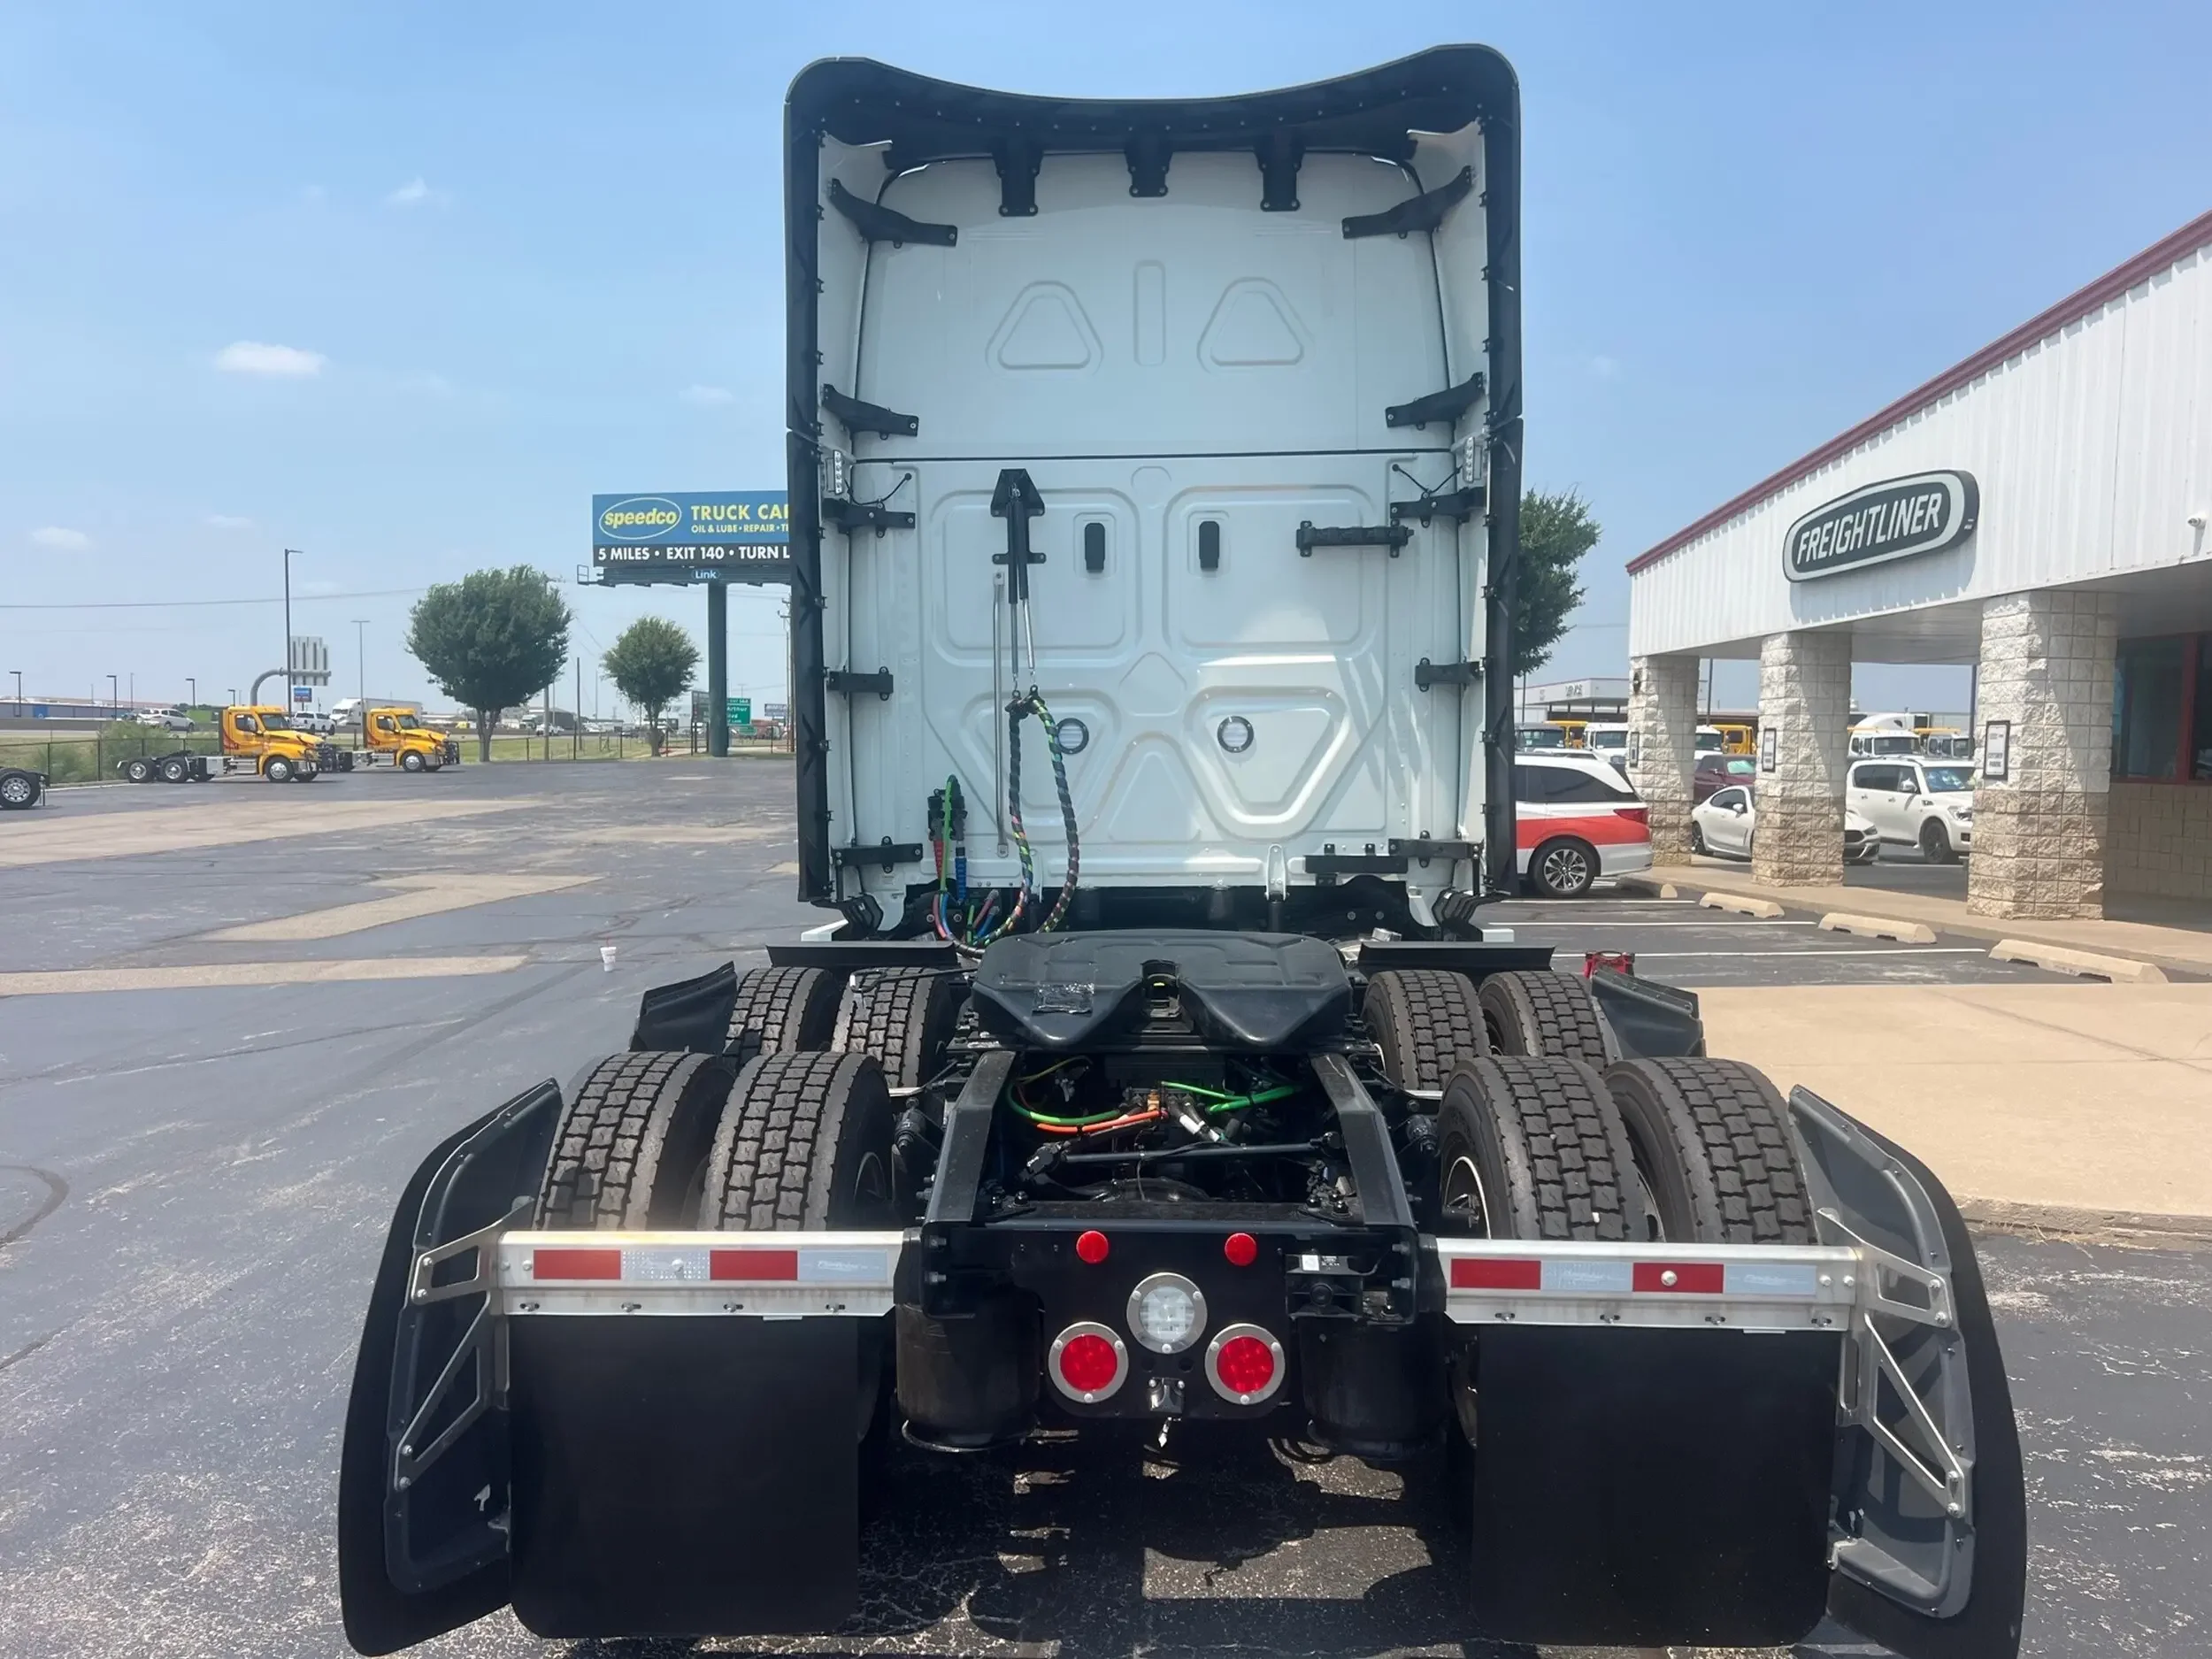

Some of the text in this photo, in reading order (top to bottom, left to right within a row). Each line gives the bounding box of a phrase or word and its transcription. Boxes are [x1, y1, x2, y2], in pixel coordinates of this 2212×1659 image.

[604, 507, 677, 529] speedco
[690, 503, 750, 521] TRUCK
[691, 524, 706, 534] OIL
[708, 524, 715, 533] &
[716, 524, 738, 533] LUBE
[743, 523, 775, 533] REPAIR
[1797, 492, 1943, 565] FREIGHTLINER
[598, 548, 607, 561] 5
[611, 547, 650, 560] MILES
[666, 546, 695, 560] EXIT
[700, 546, 725, 560] 140
[738, 546, 779, 559] TURN
[695, 570, 717, 580] Link
